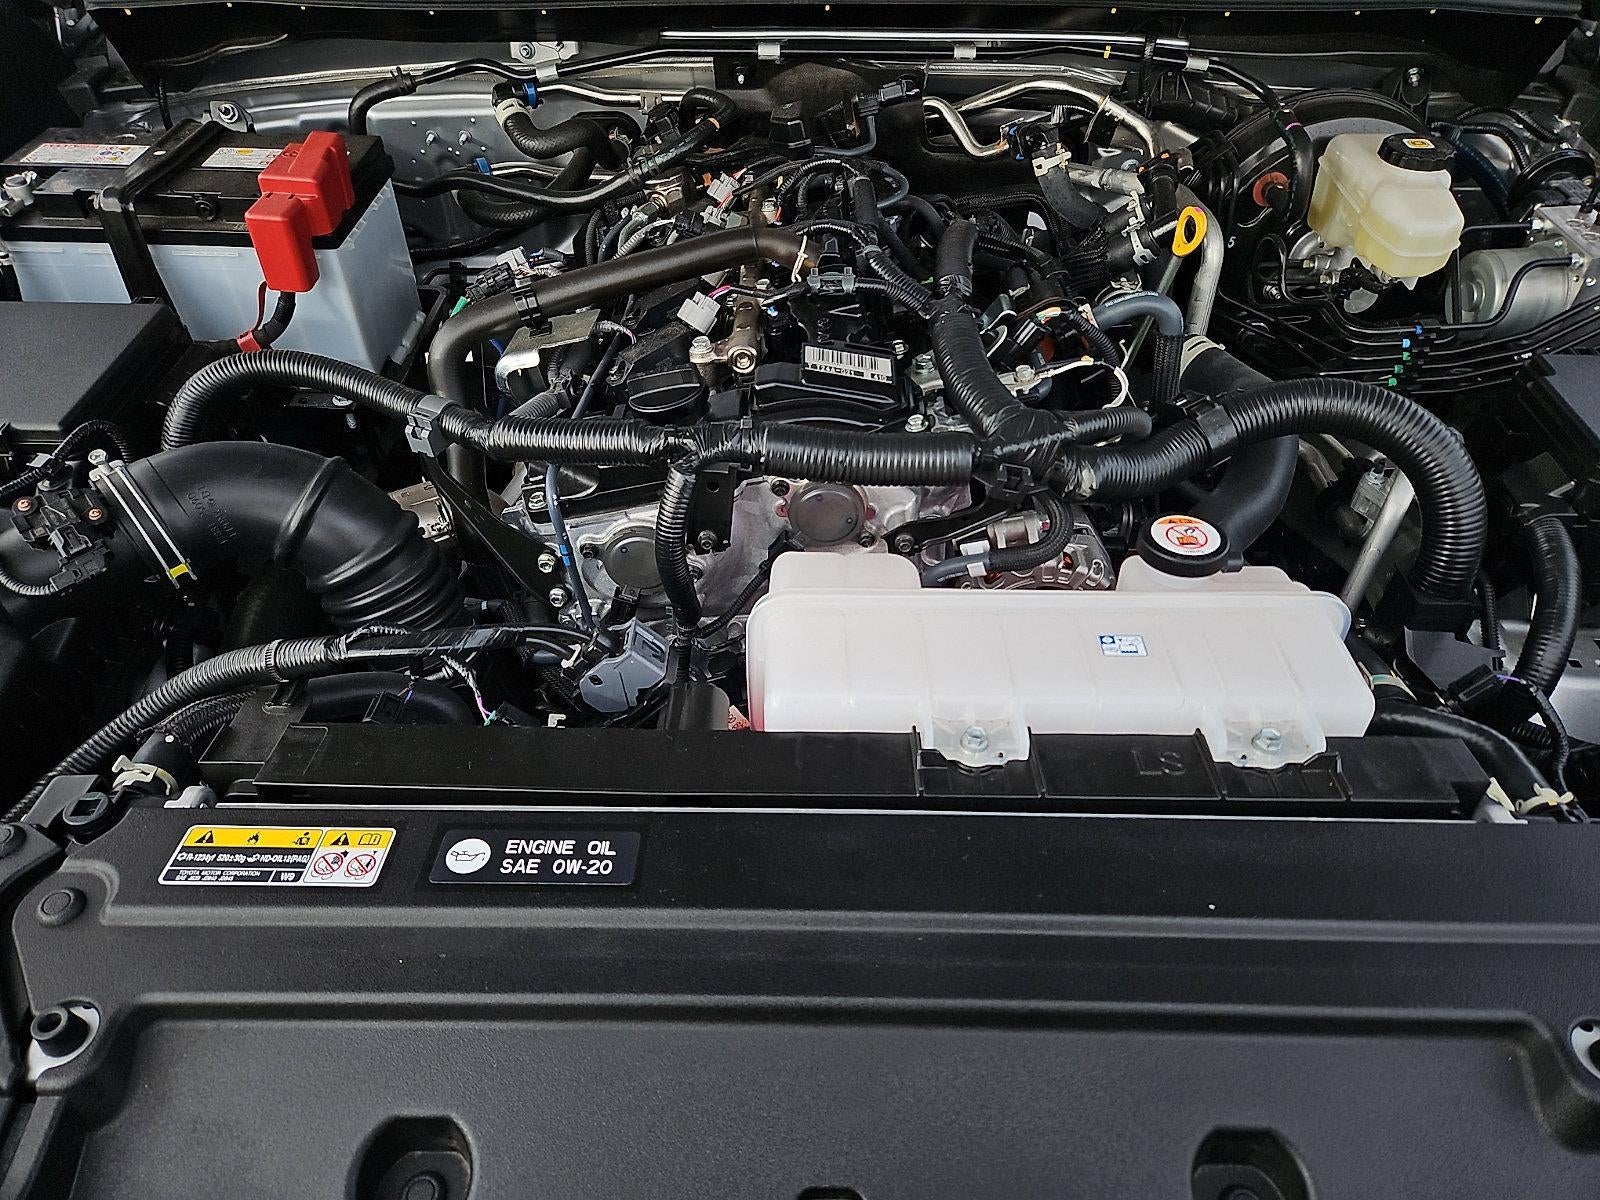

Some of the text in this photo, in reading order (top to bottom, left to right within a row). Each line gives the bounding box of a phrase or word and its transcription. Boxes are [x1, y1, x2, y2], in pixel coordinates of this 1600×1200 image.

[1228, 236, 1237, 249] 5
[1131, 750, 1187, 775] LS
[504, 839, 616, 856] ENGINE OIL
[500, 858, 613, 875] SAE 0W-20
